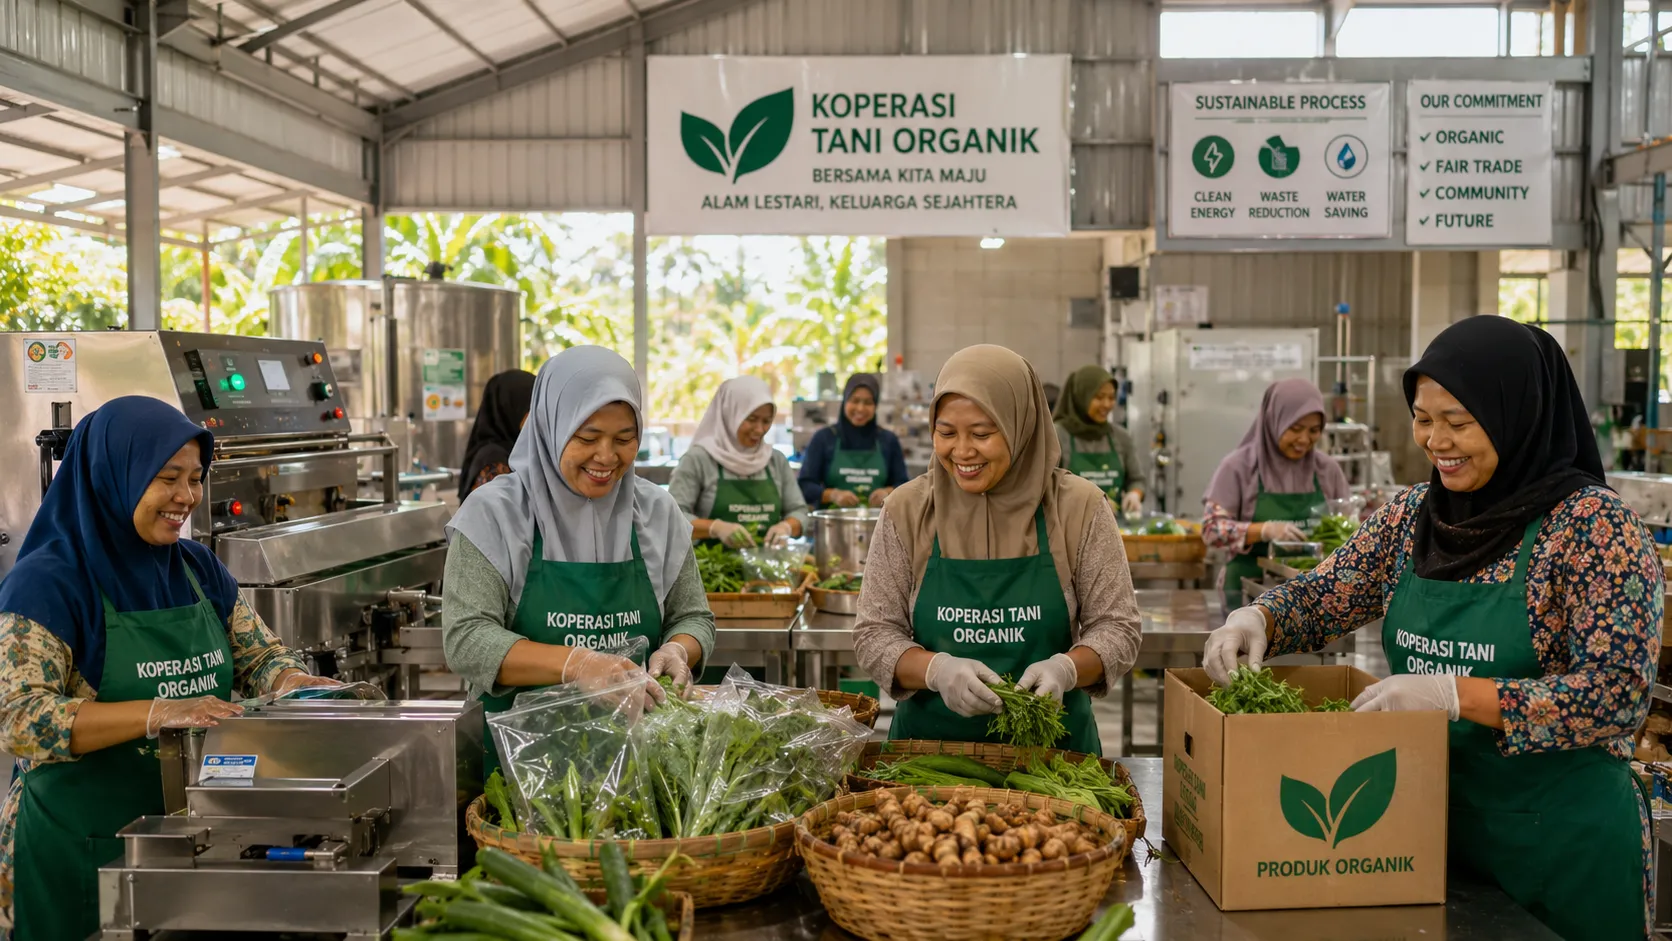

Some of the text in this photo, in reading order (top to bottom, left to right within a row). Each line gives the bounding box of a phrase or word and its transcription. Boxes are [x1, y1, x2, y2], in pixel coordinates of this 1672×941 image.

[812, 92, 955, 119] KOPERASI
[1195, 94, 1366, 110] SUSTAINABLE PROCESS
[1420, 93, 1544, 109] OUR COMMITMENT
[811, 127, 1040, 154] TANI ORGANIK
[1435, 129, 1504, 145] ORGANIC
[1436, 159, 1523, 174] FAIR TRADE
[812, 167, 987, 184] BERSAMA KITA MAJU
[1194, 190, 1232, 203] CLEAN
[1259, 190, 1299, 203] WASTE
[1326, 190, 1366, 202] WATER
[1435, 185, 1529, 200] COMMUNITY
[701, 194, 1018, 213] ALAM LESTARI, KELUARGA SEJAHTERA
[1190, 207, 1236, 219] ENERGY
[1248, 206, 1310, 219] REDUCTION
[1324, 206, 1369, 219] SAVING
[1435, 213, 1494, 228] FUTURE
[546, 609, 641, 630] KOPERASI TANI
[937, 605, 1041, 624] KOPERASI TANI
[564, 631, 630, 650] ORGANIK
[953, 627, 1025, 644] ORGANIK
[1395, 628, 1495, 662] KOPERASI TANI
[136, 648, 225, 679] KOPERASI TANI
[1407, 655, 1474, 677] ORGANIK
[157, 672, 219, 699] ORGANIK
[1257, 855, 1415, 878] PRODUK ORGANIK
